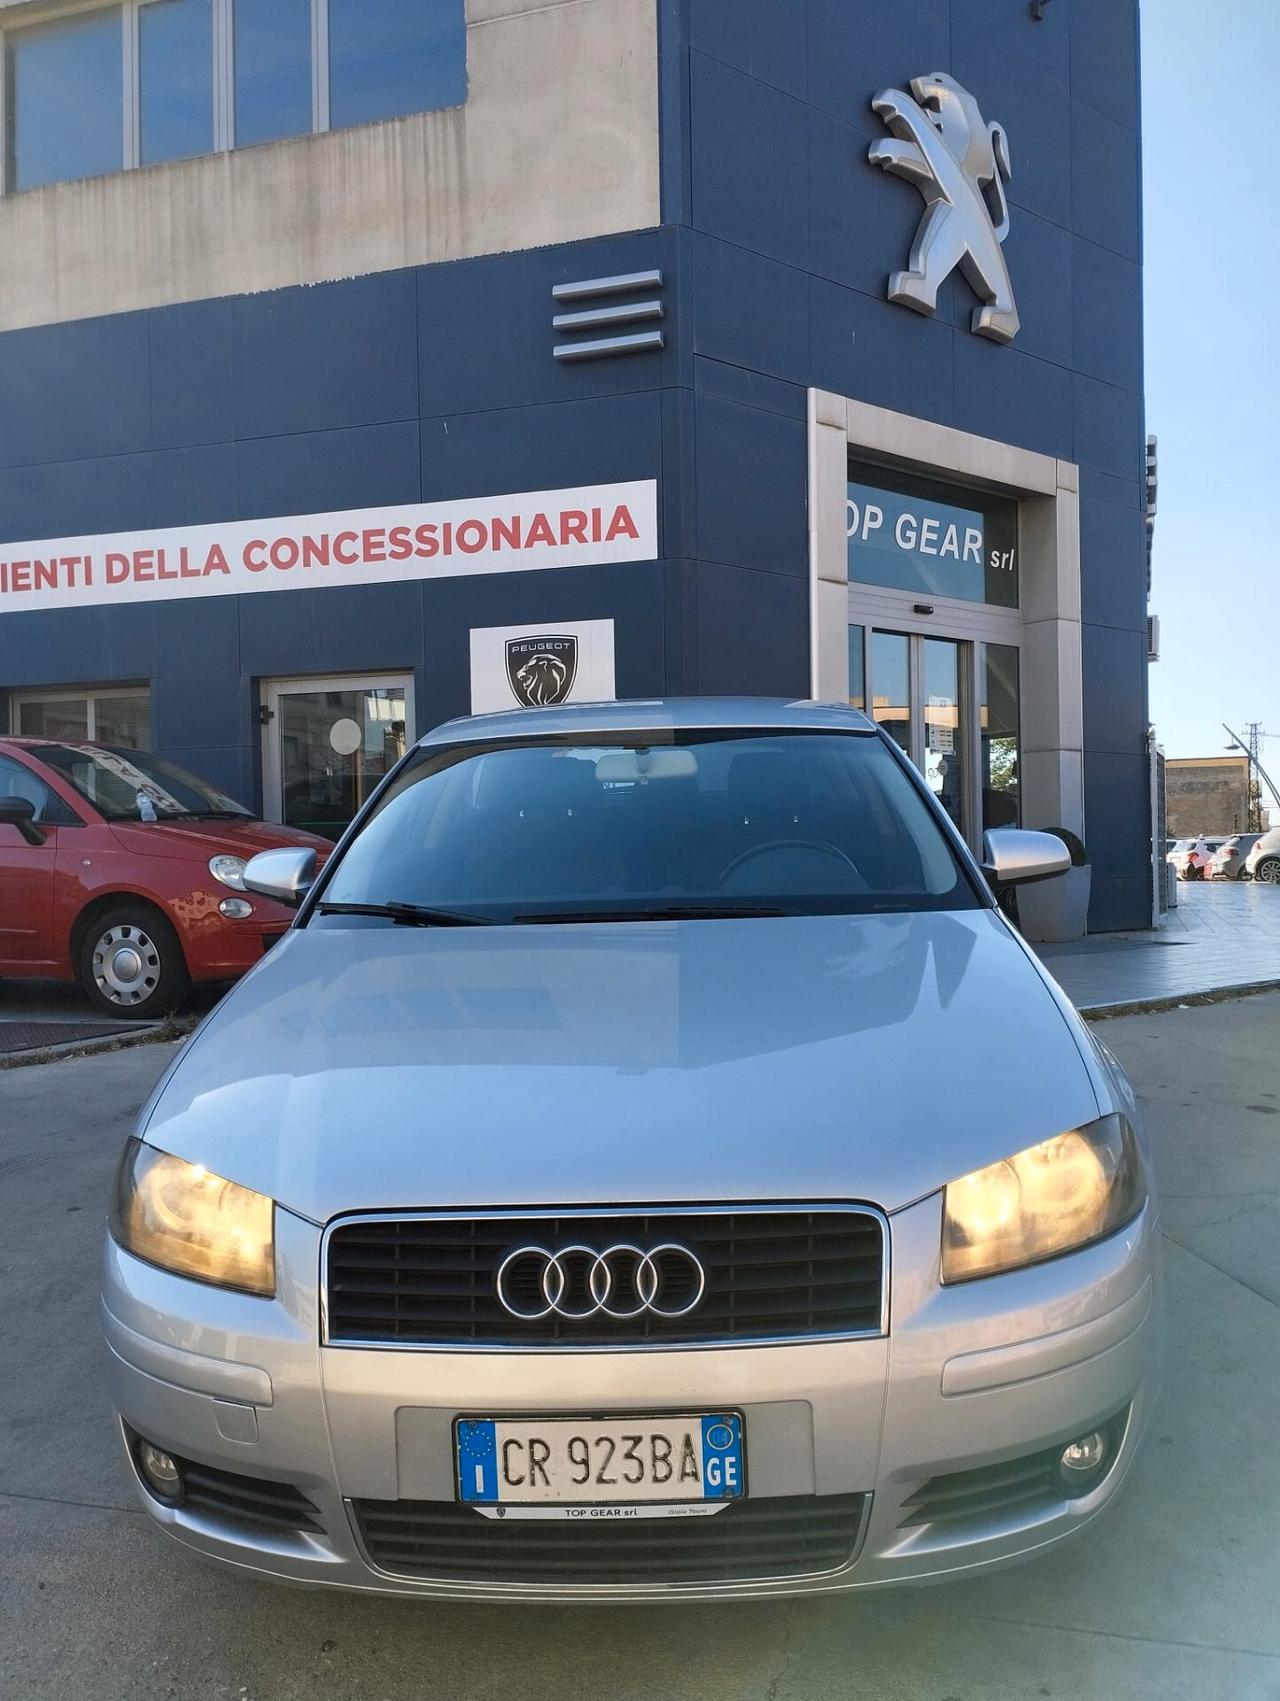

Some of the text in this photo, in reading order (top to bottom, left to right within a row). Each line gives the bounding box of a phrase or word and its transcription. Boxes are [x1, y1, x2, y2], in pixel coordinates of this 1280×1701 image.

[0, 504, 640, 593] IENTI DELLA CONCESSIONARIA
[895, 513, 983, 564] GEAR
[990, 549, 1015, 571] srl
[511, 642, 571, 653] PEUGEOT
[475, 1433, 737, 1493] I CR 923BA GE
[564, 1508, 637, 1517] TOP GEAR srl
